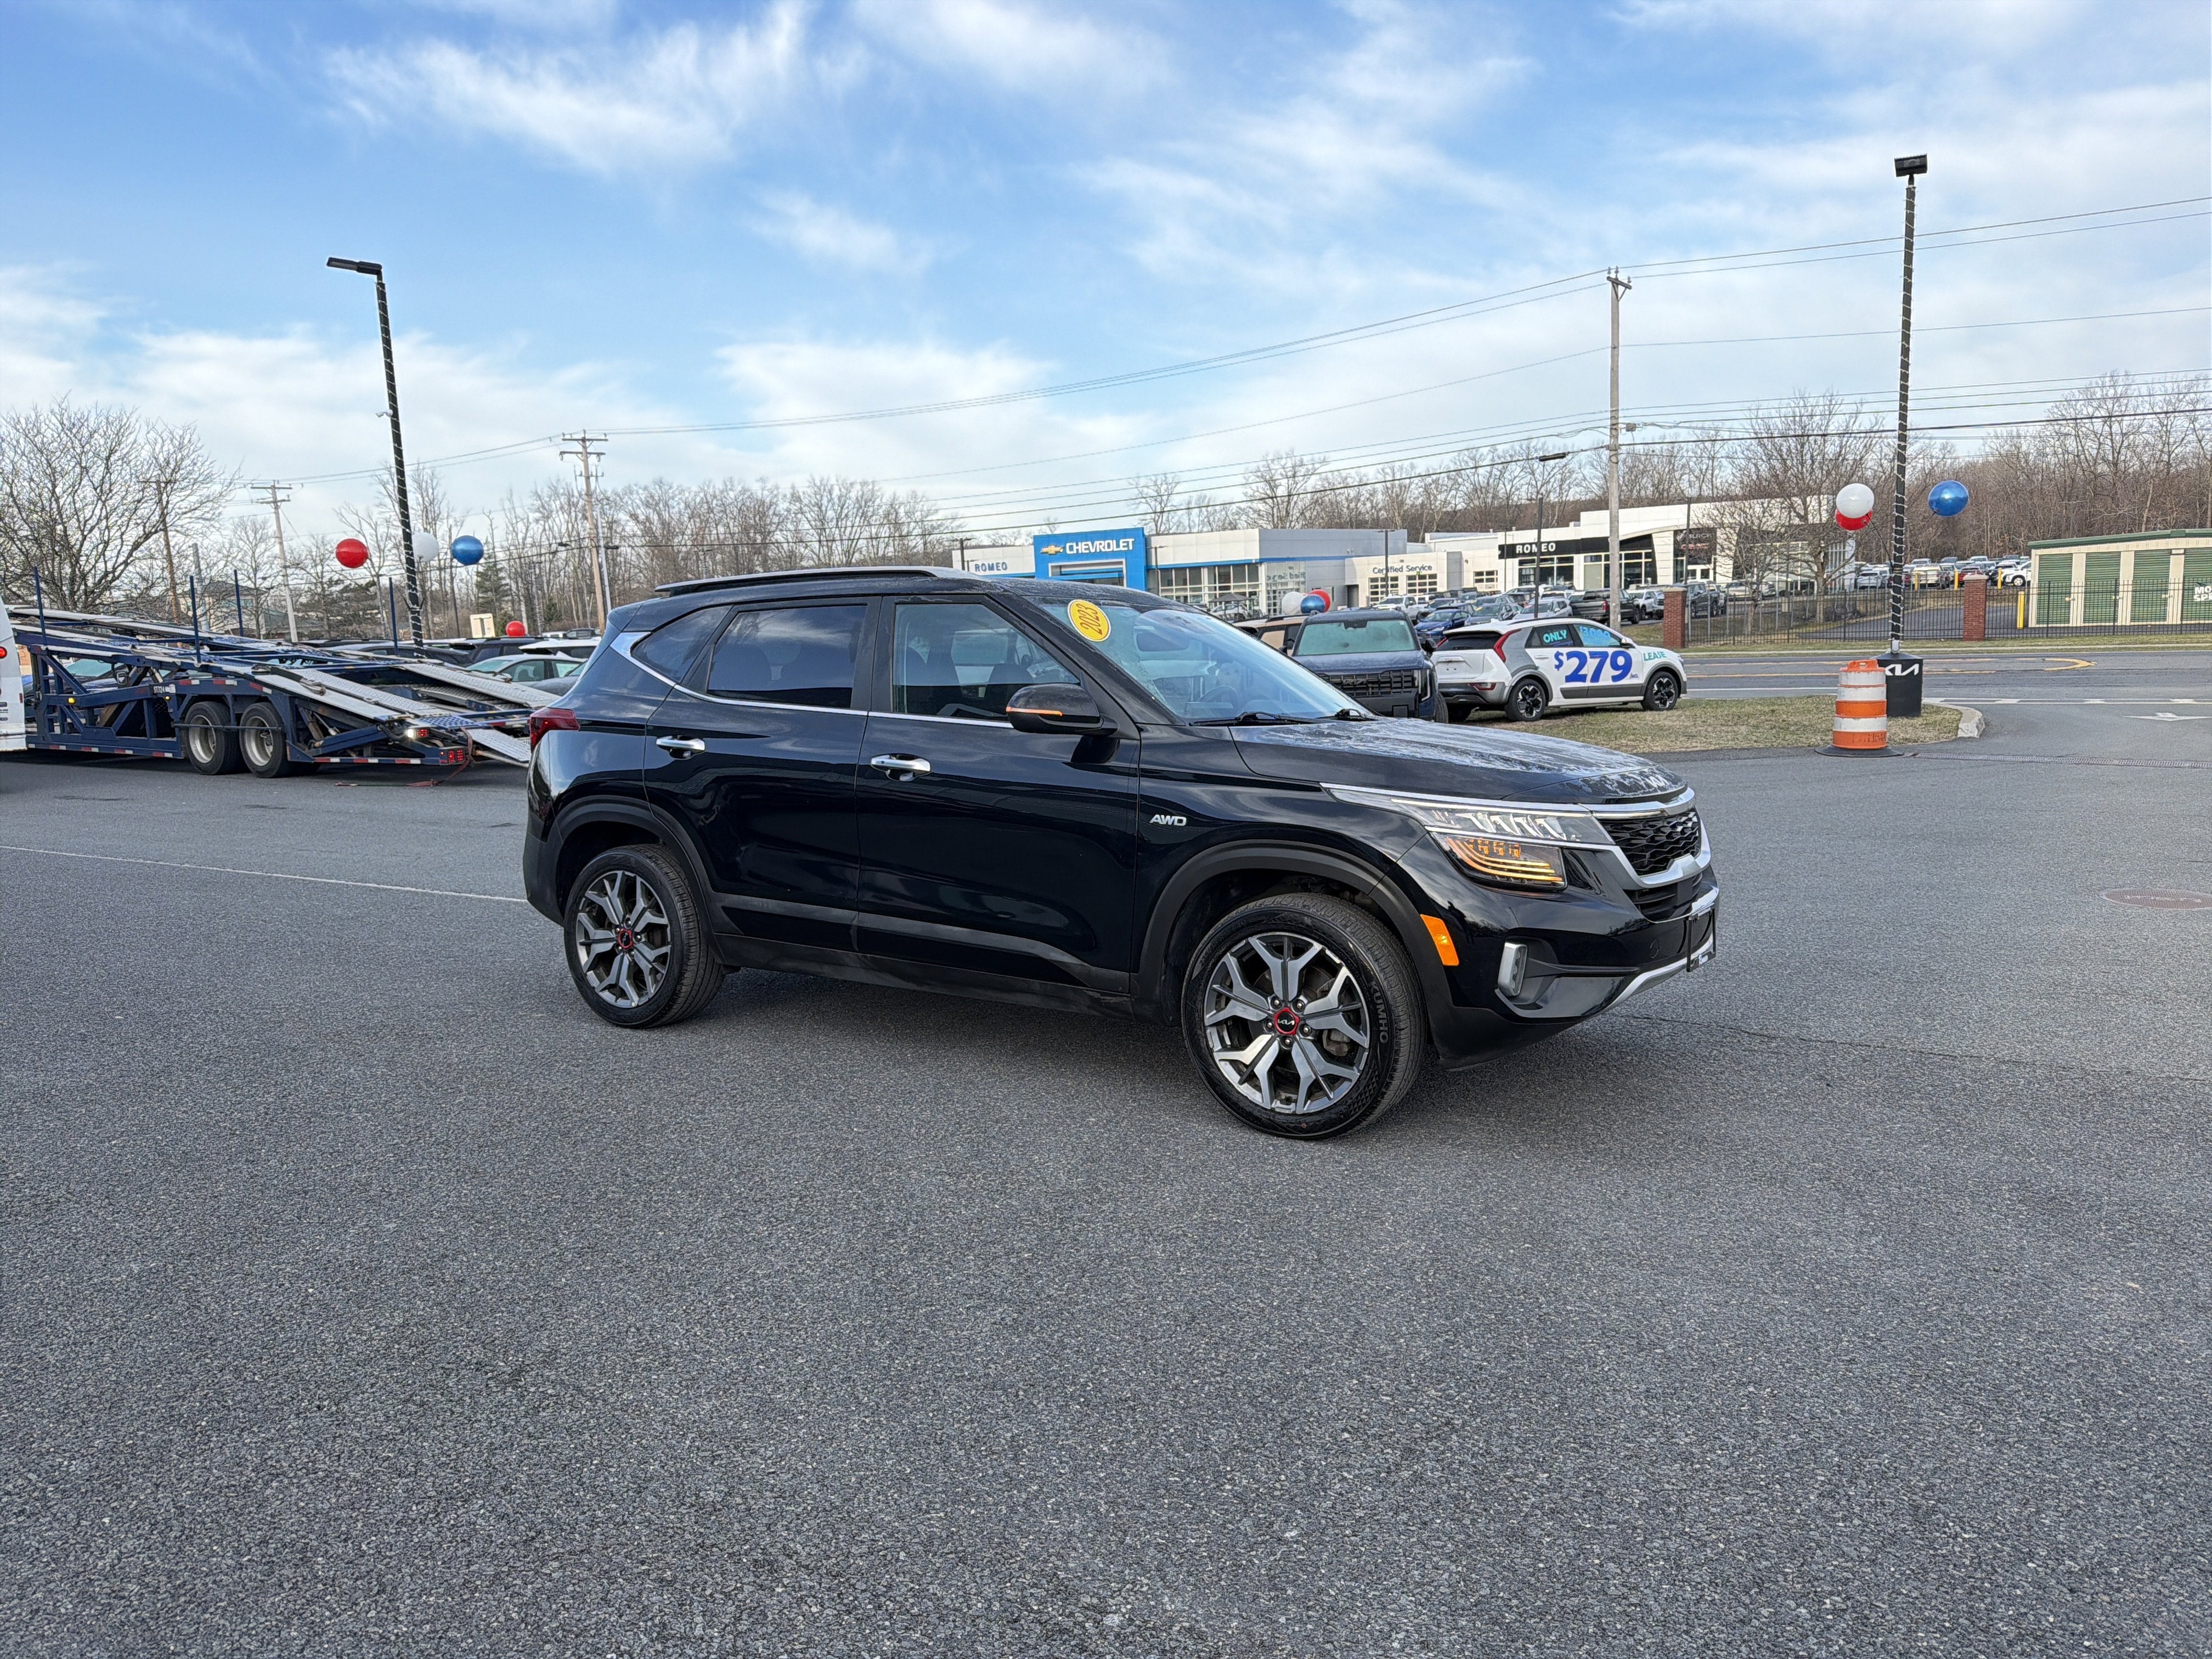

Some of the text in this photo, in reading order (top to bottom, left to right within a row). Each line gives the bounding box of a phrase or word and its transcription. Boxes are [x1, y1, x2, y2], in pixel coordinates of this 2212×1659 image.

[1065, 538, 1135, 554] CHEVROLET
[1516, 543, 1556, 554] ROMEO
[974, 561, 1008, 572] ROMEO
[1372, 564, 1432, 574] Cerified Service
[2194, 585, 2212, 594] MO
[1076, 603, 1103, 636] 2023
[1543, 630, 1567, 643] ONLY
[1643, 651, 1667, 662] LEASE
[1554, 650, 1633, 683] $279
[1149, 814, 1187, 826] AWD
[1371, 977, 1389, 1043] KUMHO
